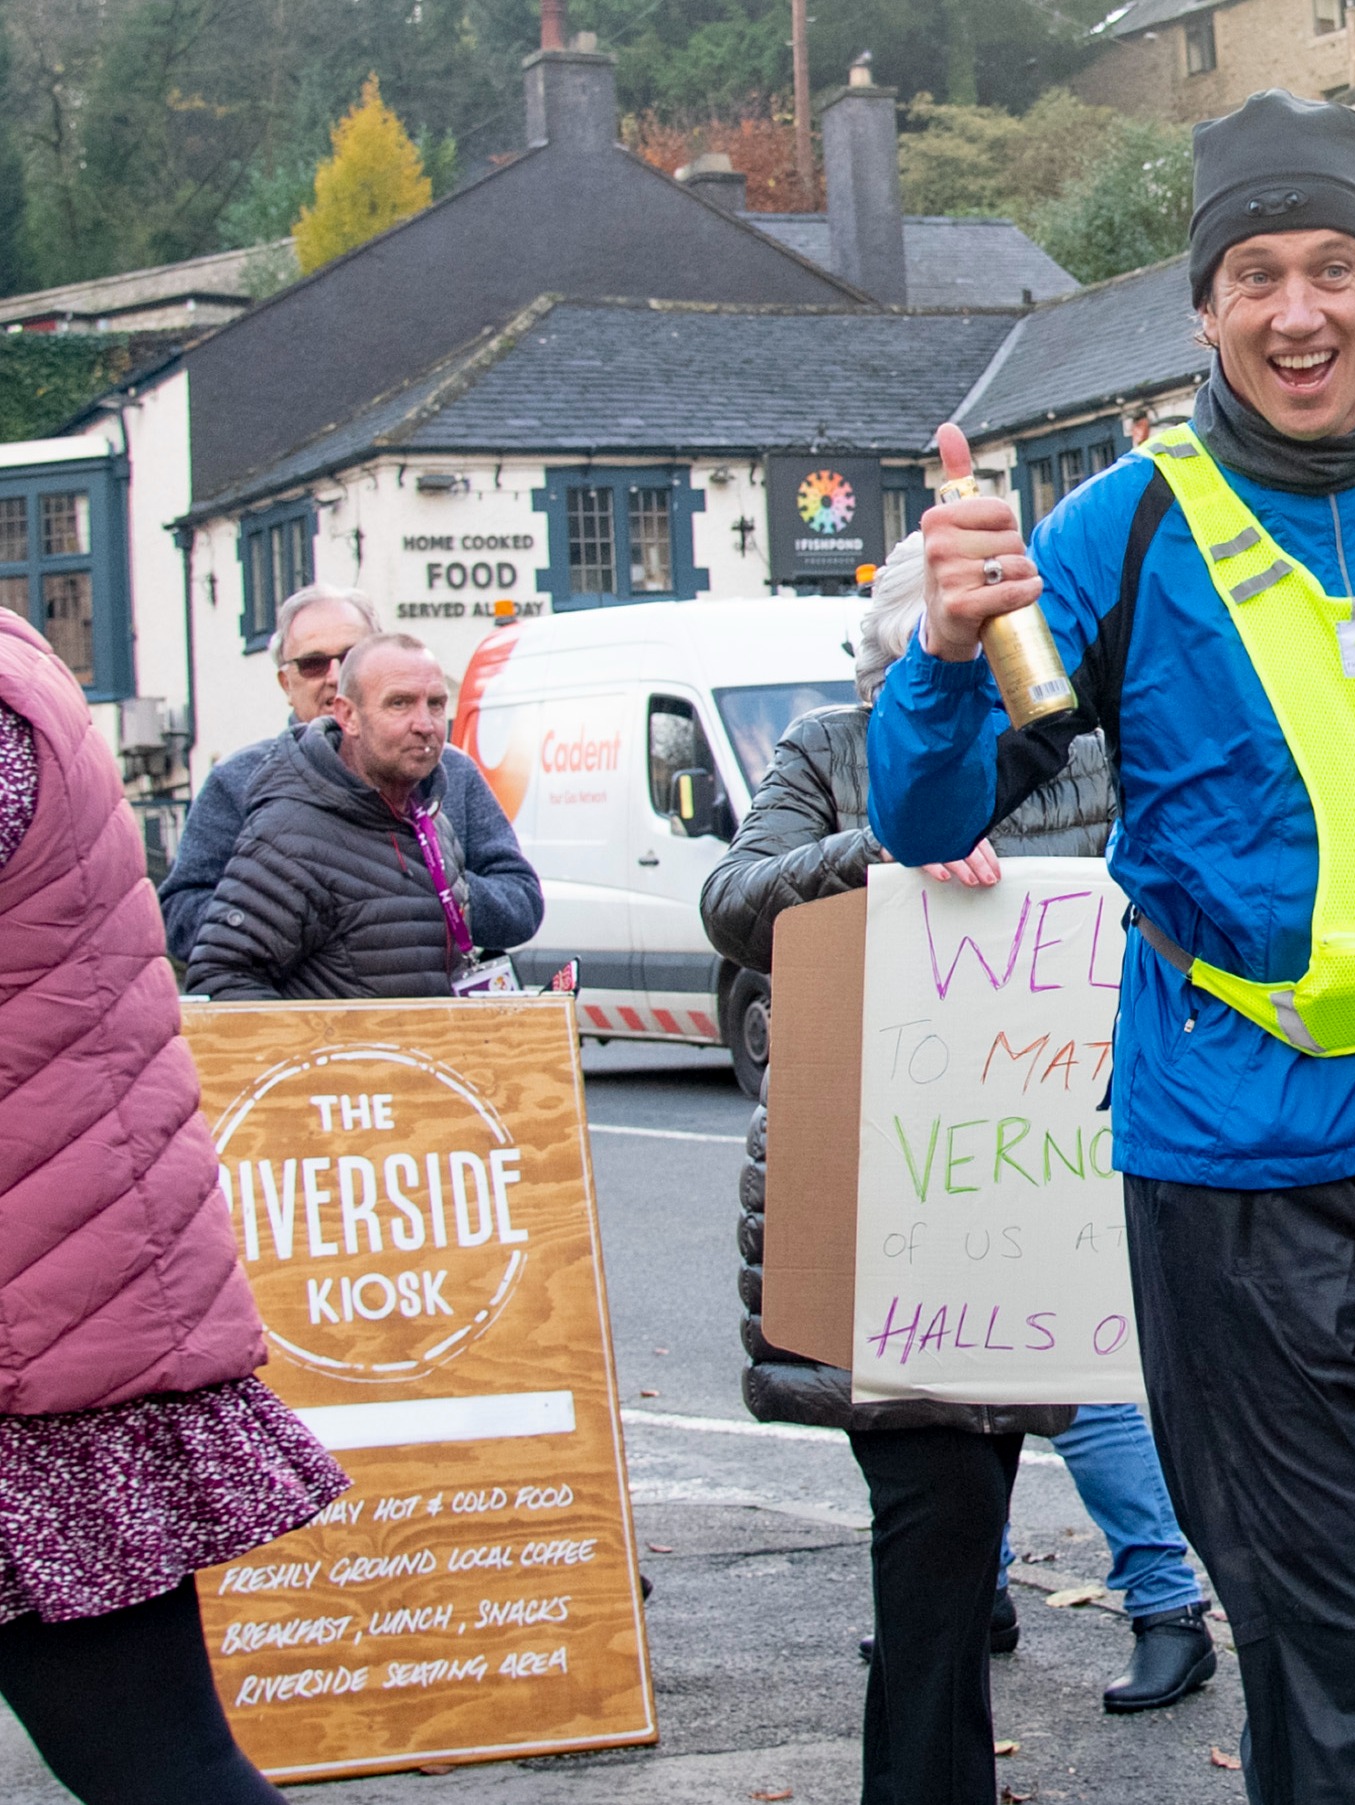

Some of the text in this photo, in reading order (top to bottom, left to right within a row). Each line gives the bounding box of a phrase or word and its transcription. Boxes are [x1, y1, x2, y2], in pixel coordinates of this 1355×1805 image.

[403, 534, 534, 551] HOME COOKED
[427, 561, 517, 590] FOOD
[397, 602, 465, 618] SERVED
[541, 721, 622, 775] Cadent
[878, 1018, 950, 1085] TO
[310, 1093, 395, 1133] THE
[964, 1225, 1023, 1261] US
[307, 1269, 454, 1325] KIOSK
[866, 1295, 1057, 1366] HALLS
[374, 1493, 420, 1523] HOT
[426, 1491, 444, 1516] &
[452, 1486, 508, 1514] COLD
[514, 1482, 575, 1510] FOOD
[218, 1537, 598, 1596] FRESHLY GROUND LOCAL COFFEE
[474, 1595, 573, 1629] SNACKS
[234, 1646, 569, 1708] RIVERSIDE SEATING AREA
